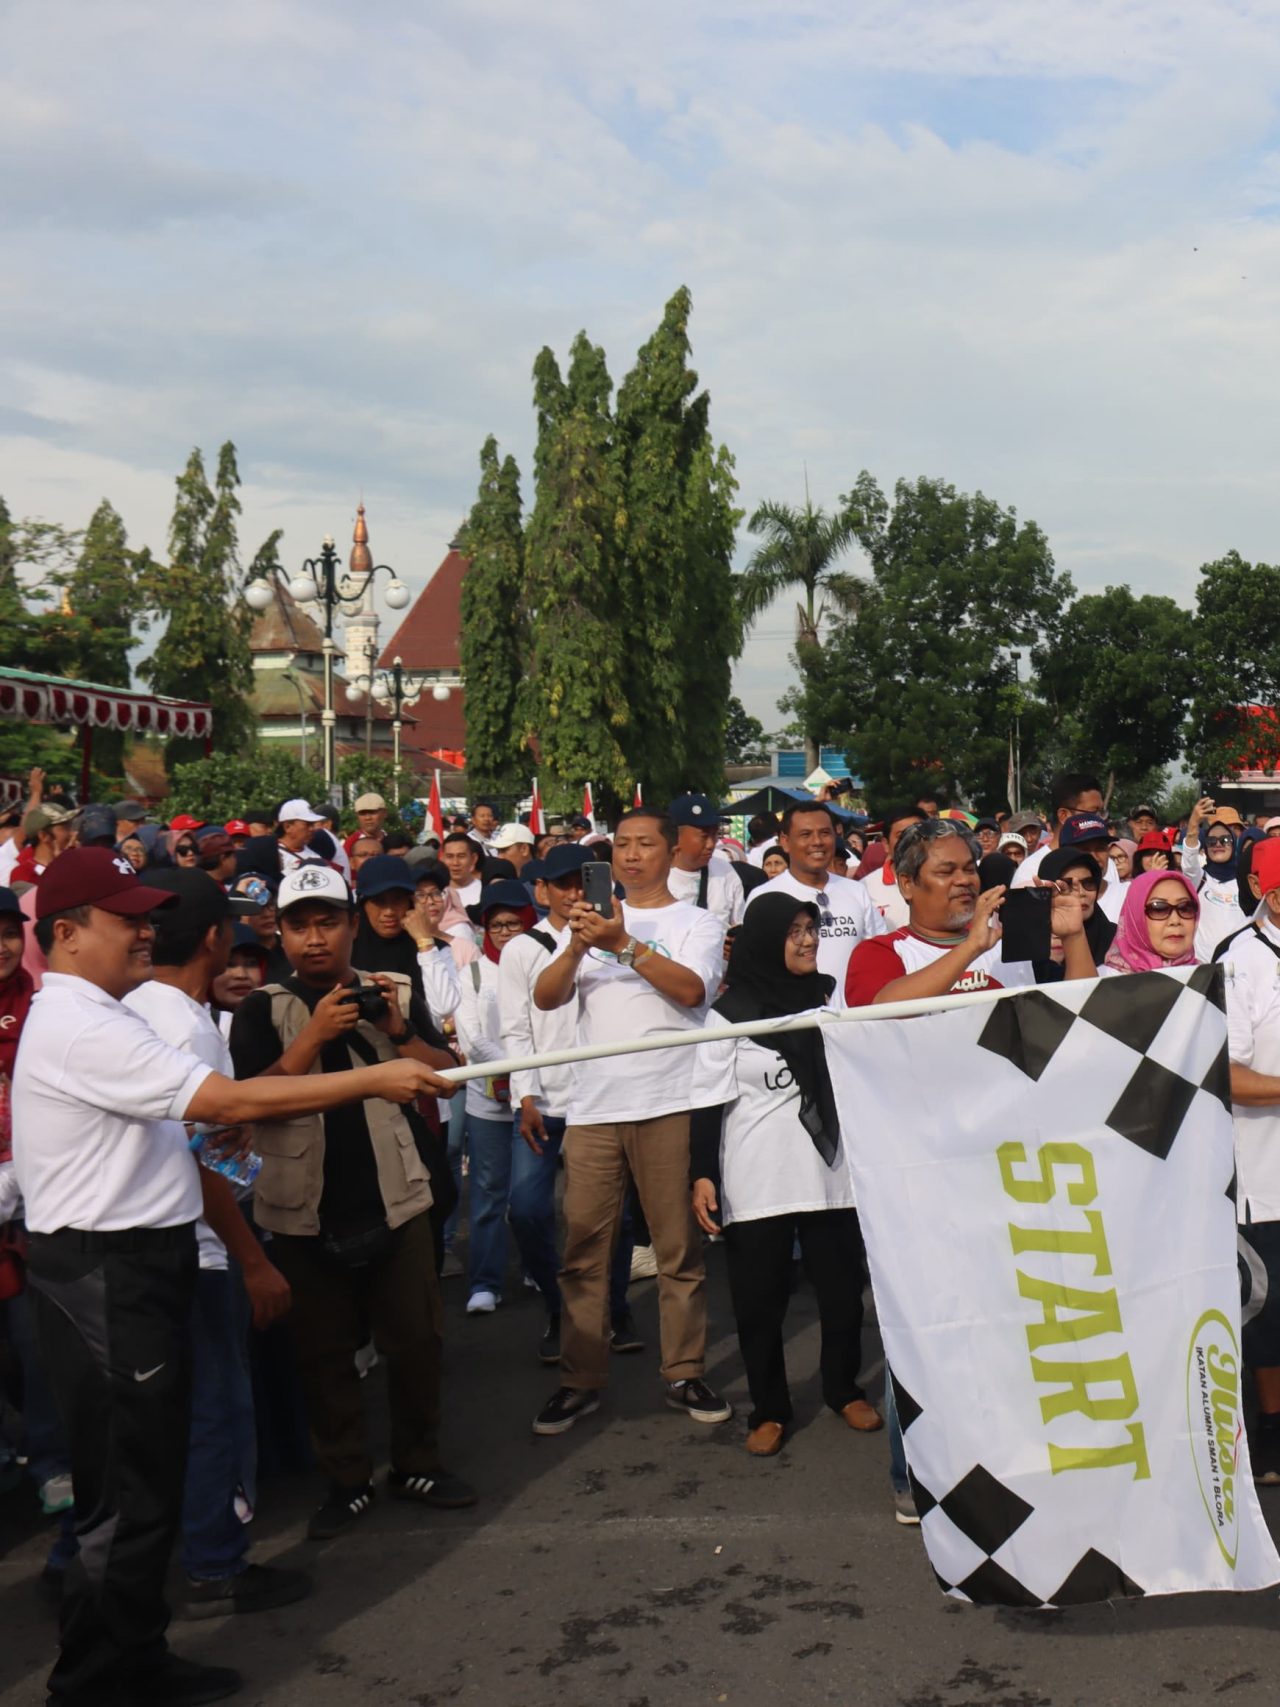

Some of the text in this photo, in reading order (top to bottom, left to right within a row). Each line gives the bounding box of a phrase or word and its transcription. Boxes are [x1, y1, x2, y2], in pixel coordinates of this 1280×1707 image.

[820, 926, 858, 938] BLORA
[996, 1141, 1151, 1482] START
[1195, 1346, 1207, 1389] IKATAN
[1201, 1390, 1214, 1436] ALUMNI
[1207, 1439, 1219, 1474] SMAN
[1213, 1485, 1225, 1527] BLORA
